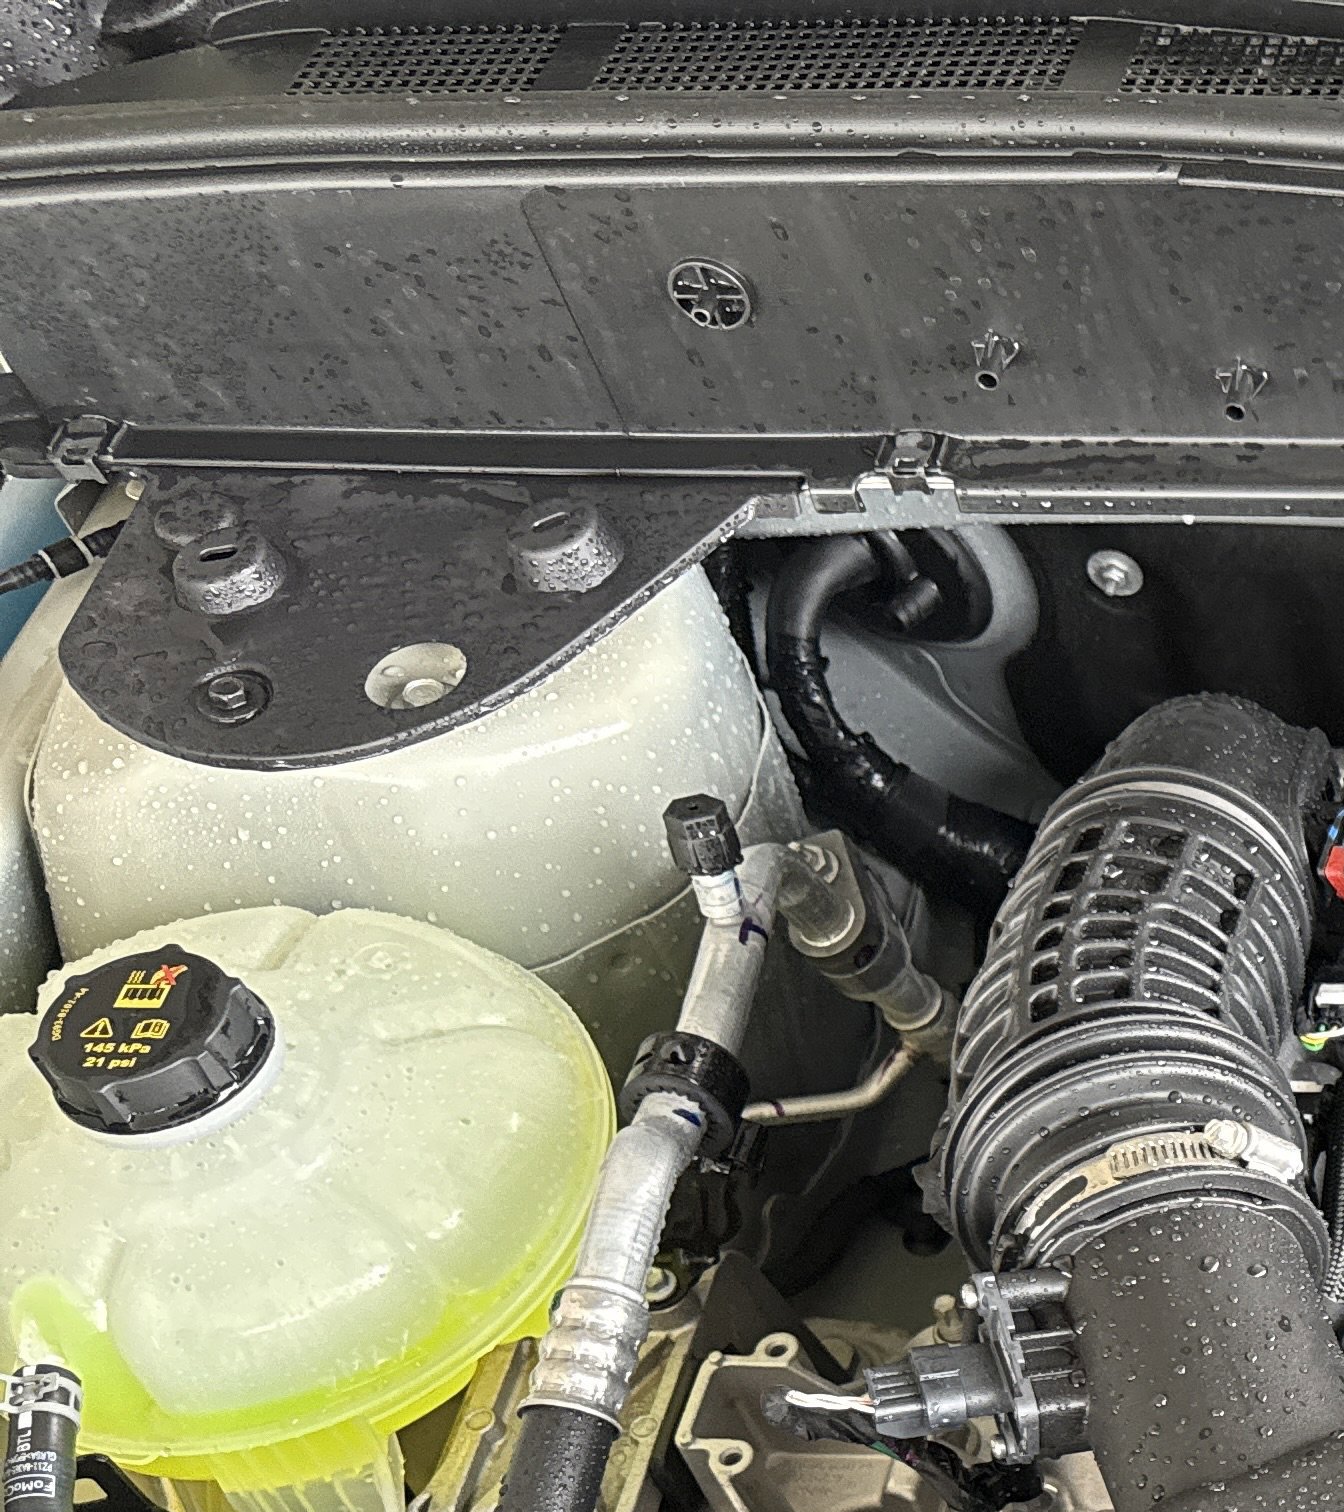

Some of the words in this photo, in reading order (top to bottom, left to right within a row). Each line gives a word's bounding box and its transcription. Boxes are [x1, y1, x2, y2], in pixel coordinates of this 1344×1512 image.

[82, 1043, 115, 1054] 145
[118, 1043, 152, 1054] kPa
[82, 1057, 107, 1068] 21
[108, 1057, 137, 1069] psi
[16, 1429, 32, 1452] BTL
[4, 1480, 54, 1497] FoMoC
